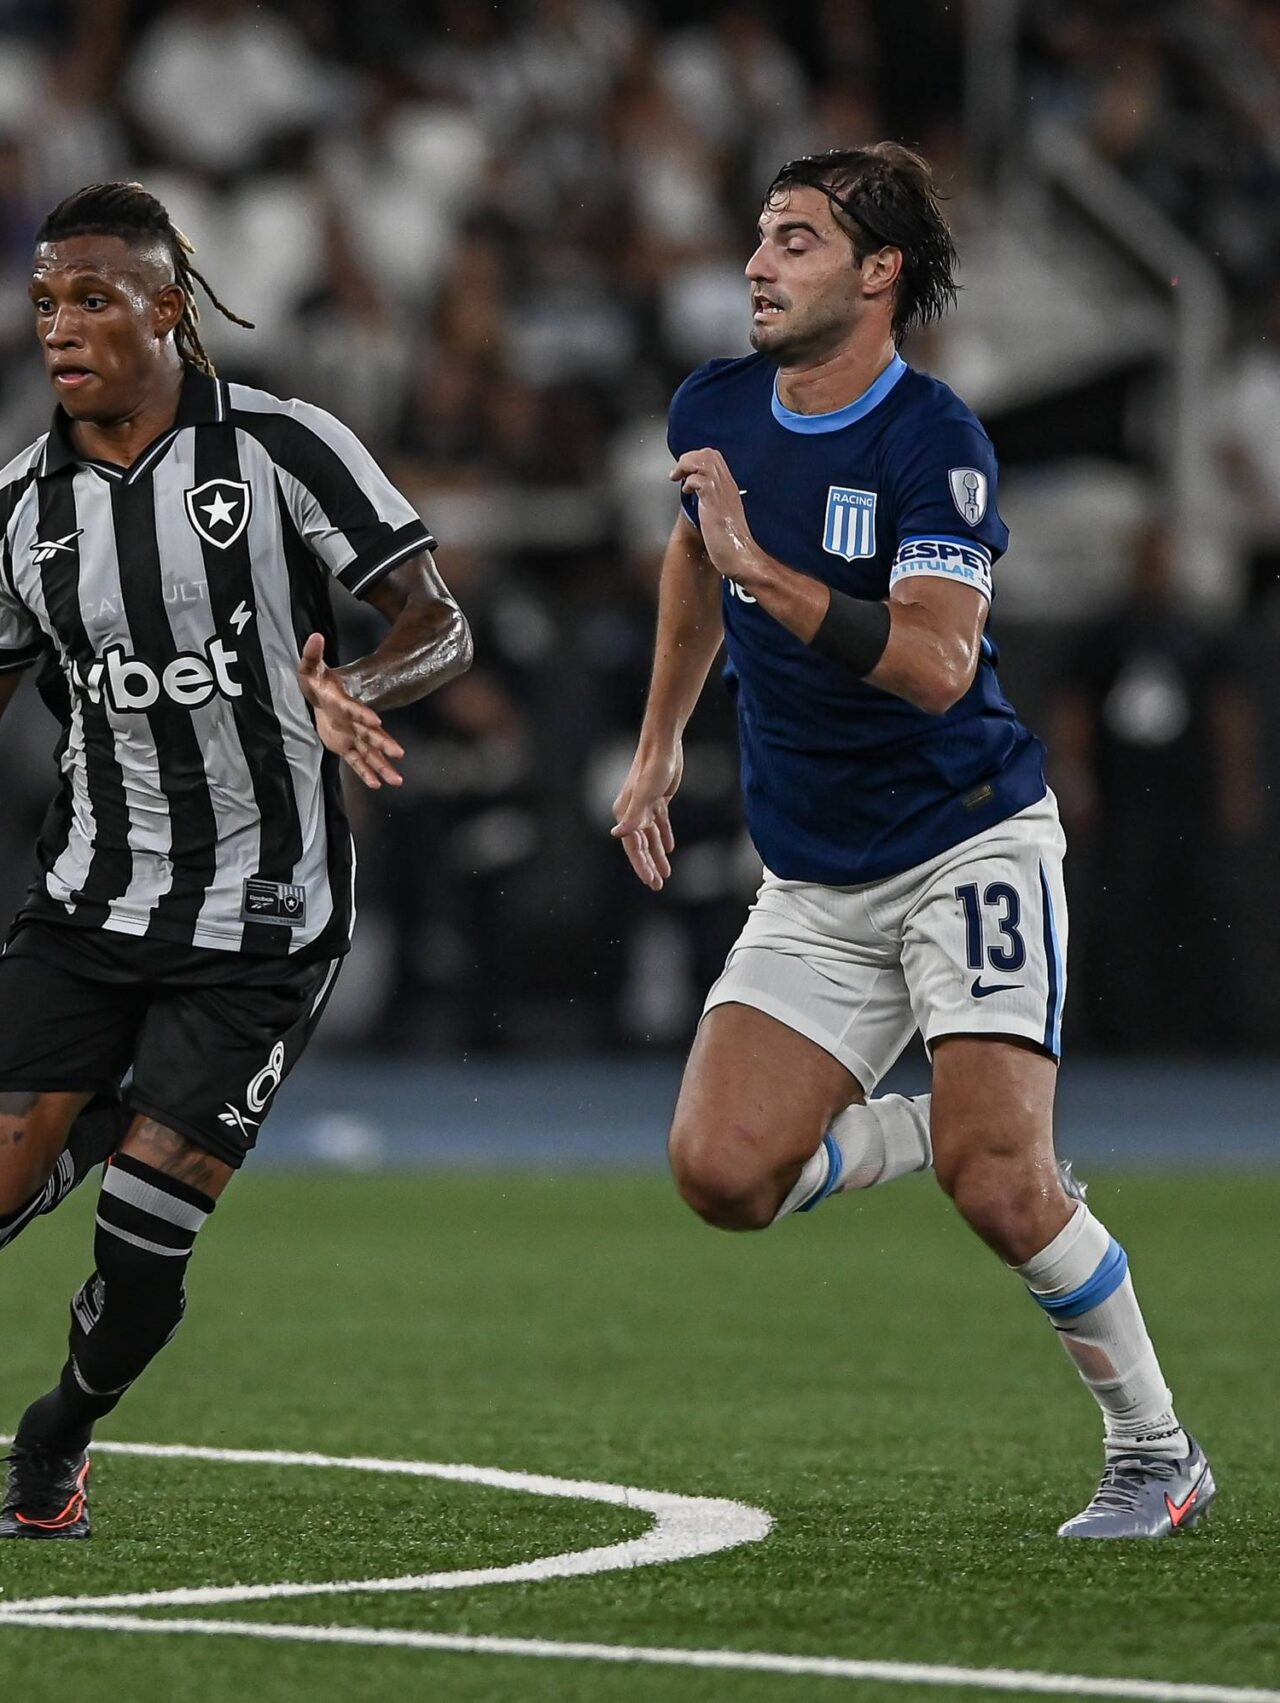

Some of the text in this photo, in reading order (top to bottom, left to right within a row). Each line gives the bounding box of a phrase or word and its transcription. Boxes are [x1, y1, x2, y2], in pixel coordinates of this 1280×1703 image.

[832, 492, 874, 508] RACING
[900, 560, 975, 581] TITULAR
[954, 881, 1026, 973] 13
[246, 1040, 285, 1113] 8
